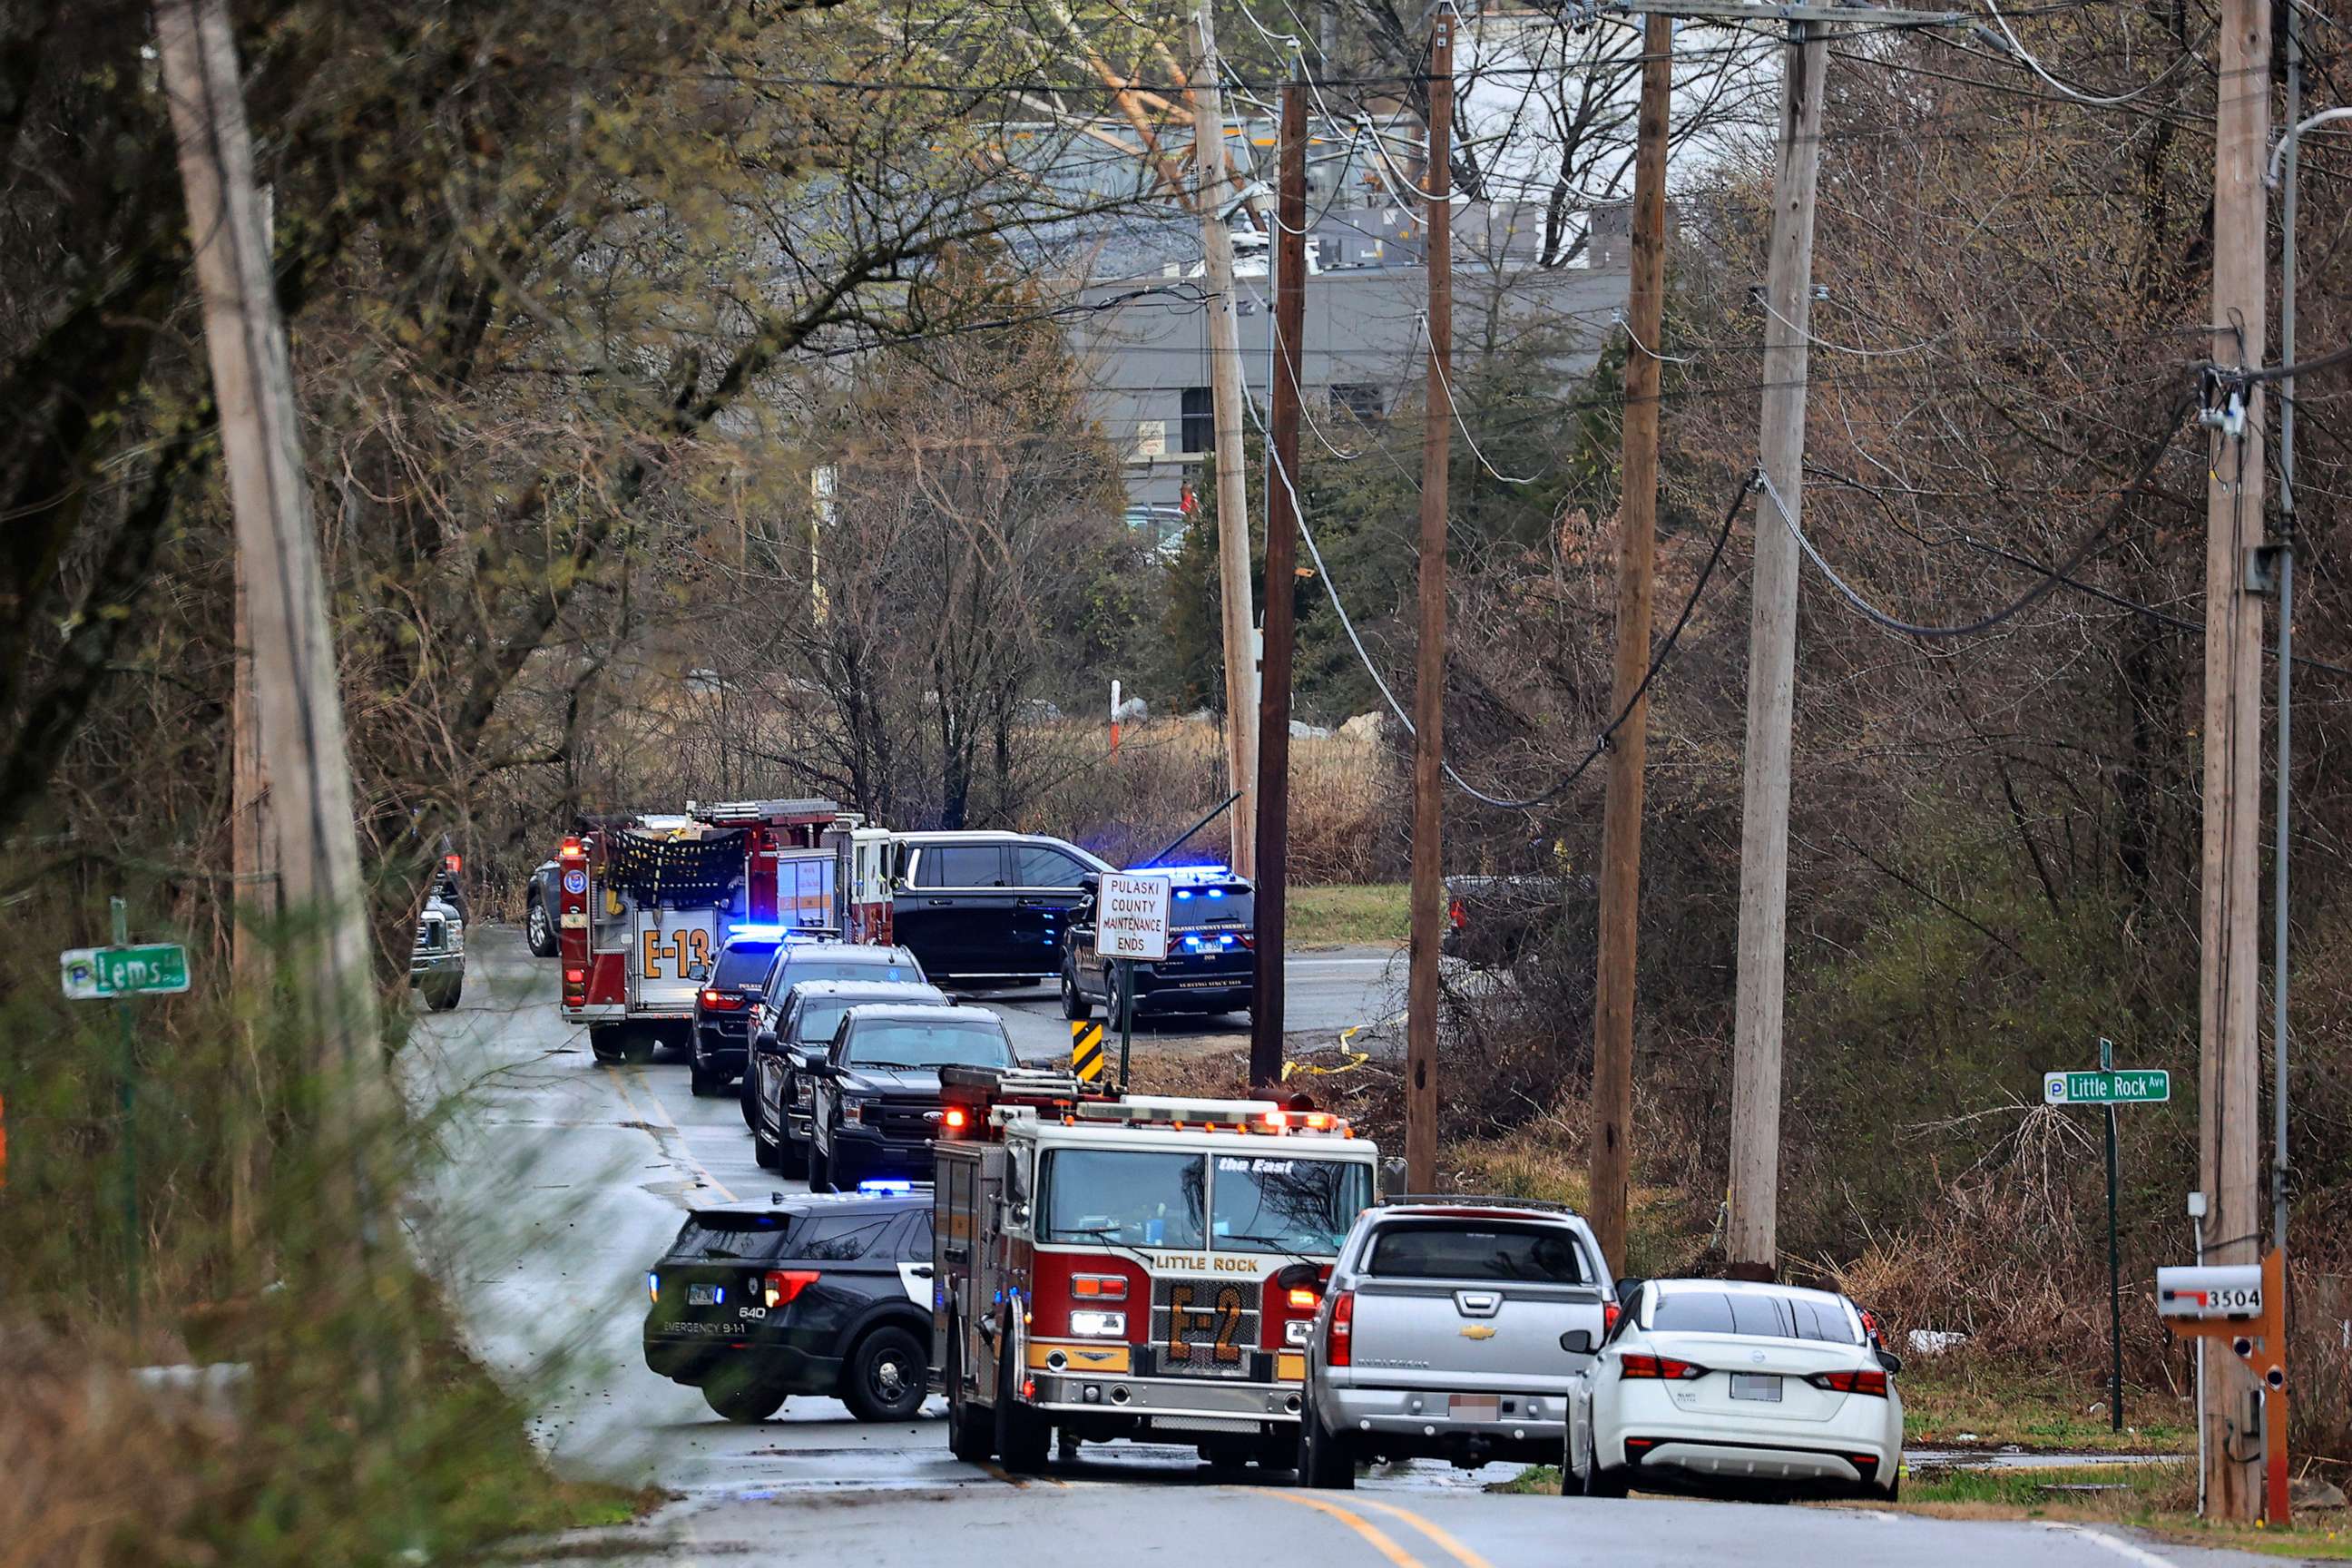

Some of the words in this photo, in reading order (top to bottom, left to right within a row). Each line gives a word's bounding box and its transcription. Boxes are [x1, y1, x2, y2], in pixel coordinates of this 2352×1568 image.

[1111, 879, 1159, 895] PULASKI
[1112, 899, 1156, 915] COUNTY
[1103, 916, 1161, 932] MAINTENANCE
[1117, 936, 1144, 952] ENDS
[643, 928, 710, 979] E-13
[2071, 1077, 2107, 1098] Little
[2114, 1076, 2148, 1097] Rock
[2149, 1076, 2165, 1087] Ave
[1219, 1158, 1249, 1171] the
[1156, 1256, 1206, 1270] LITTLE
[1214, 1259, 1259, 1272] ROCK
[2209, 1289, 2259, 1308] 3504
[739, 1308, 766, 1318] 640
[664, 1321, 720, 1333] EMERGENCY
[722, 1323, 746, 1333] 9-1-1
[1170, 1286, 1241, 1361] E-2
